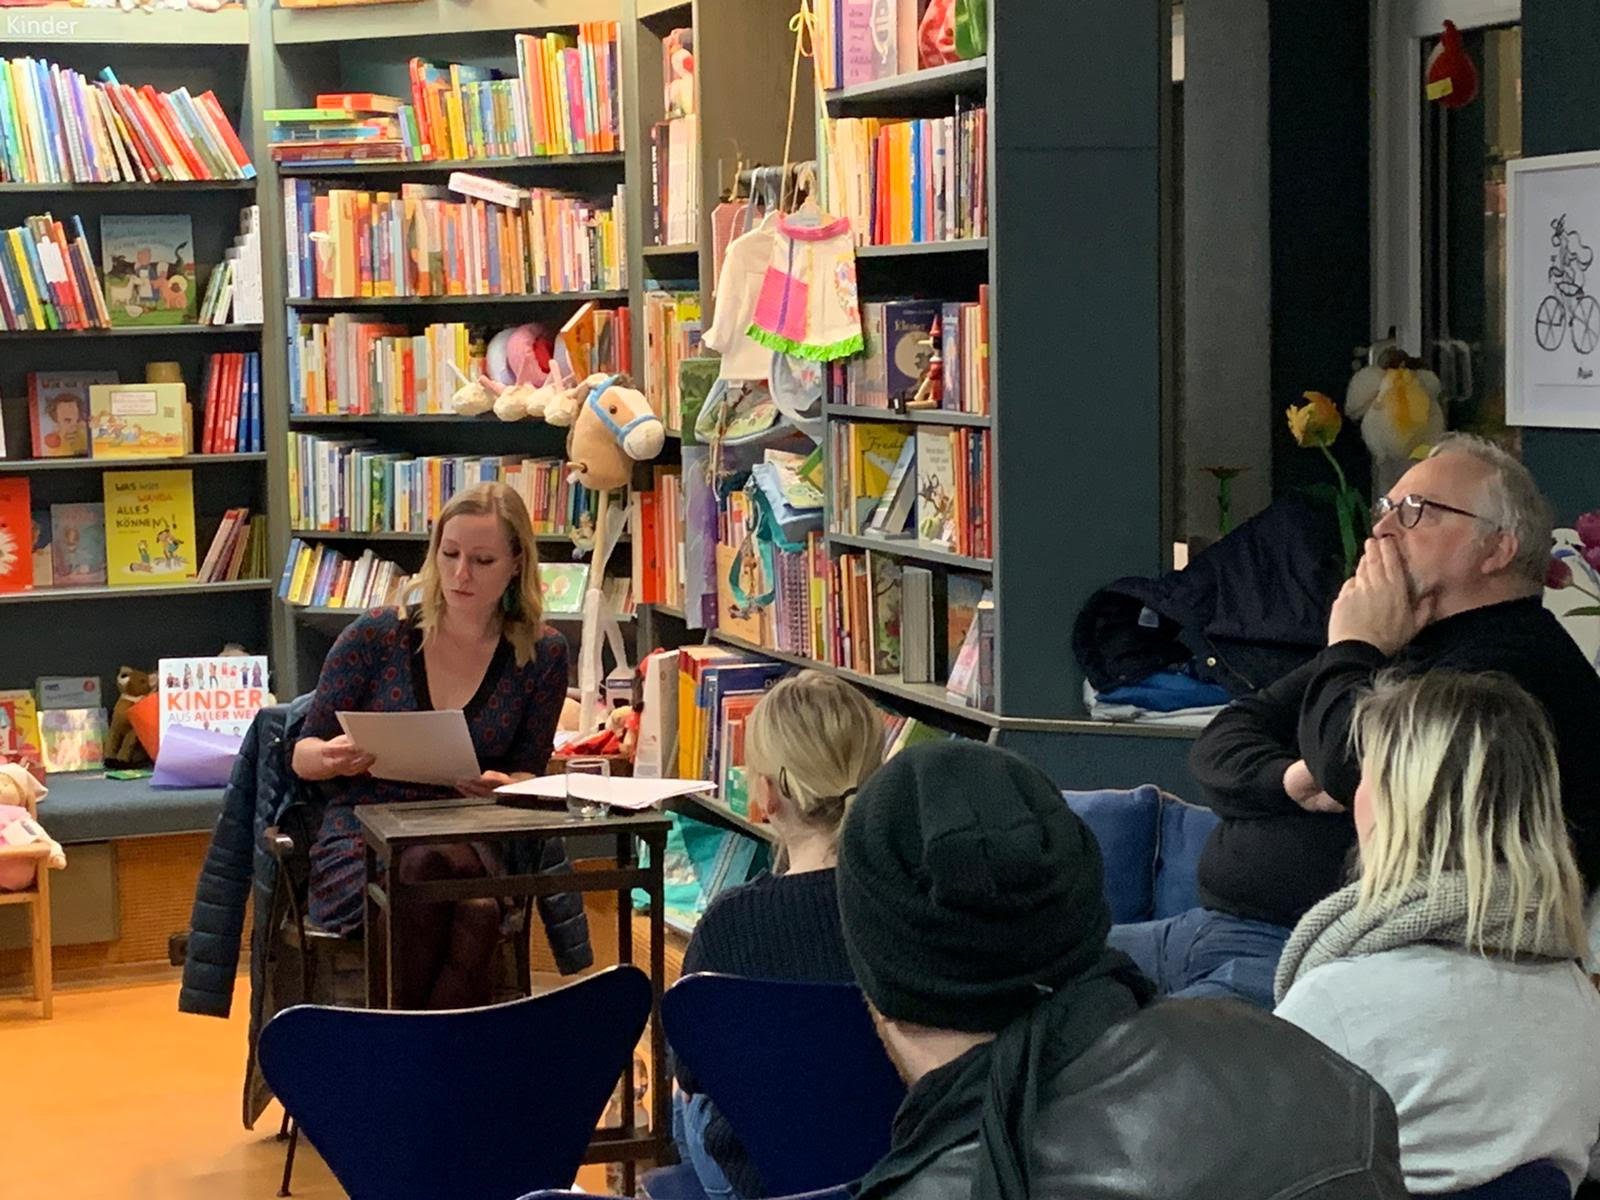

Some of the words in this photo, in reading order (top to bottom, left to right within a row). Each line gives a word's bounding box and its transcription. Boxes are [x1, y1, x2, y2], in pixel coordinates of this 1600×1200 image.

[7, 15, 79, 35] Kinder
[116, 504, 150, 515] ALLES
[167, 688, 263, 712] KINDER
[168, 712, 192, 722] AUS
[195, 711, 230, 721] ALLER
